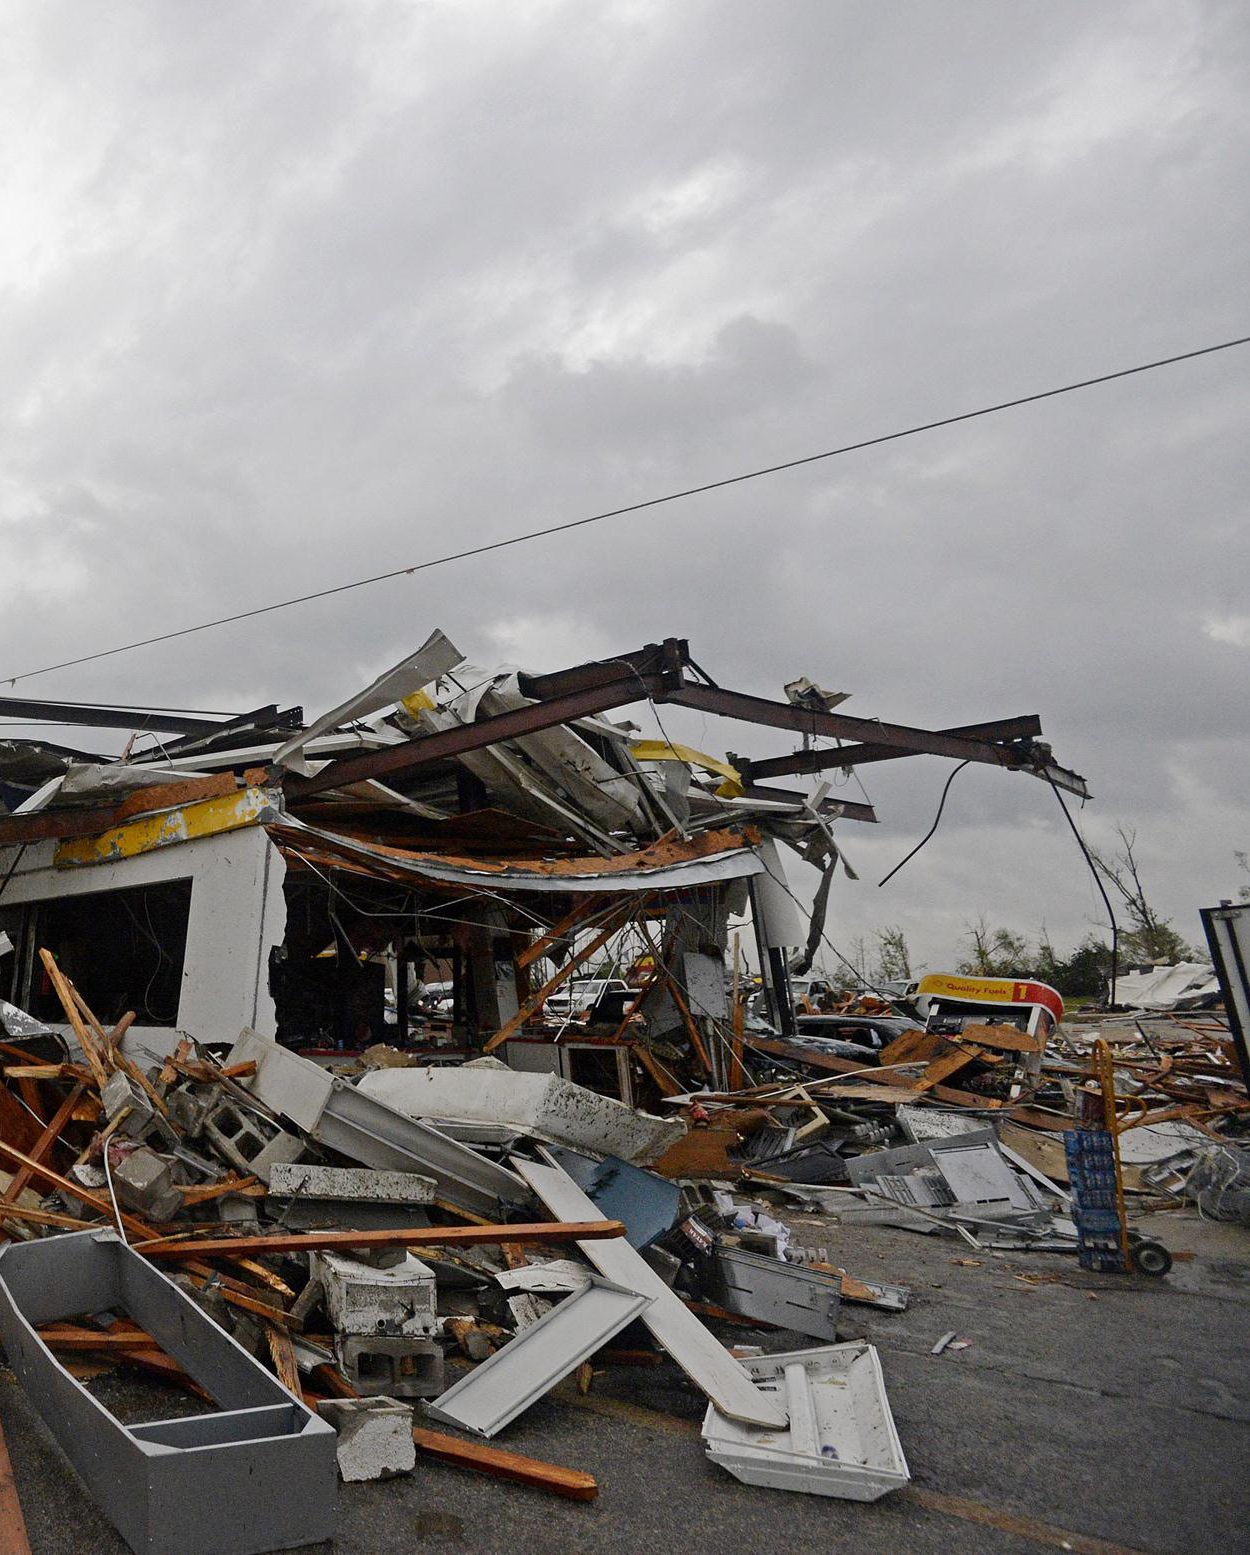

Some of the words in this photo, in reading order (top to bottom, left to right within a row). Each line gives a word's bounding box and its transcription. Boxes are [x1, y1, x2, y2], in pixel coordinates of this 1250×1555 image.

[947, 983, 981, 995] Quality
[983, 987, 1007, 995] Fuels
[1018, 985, 1028, 999] 1
